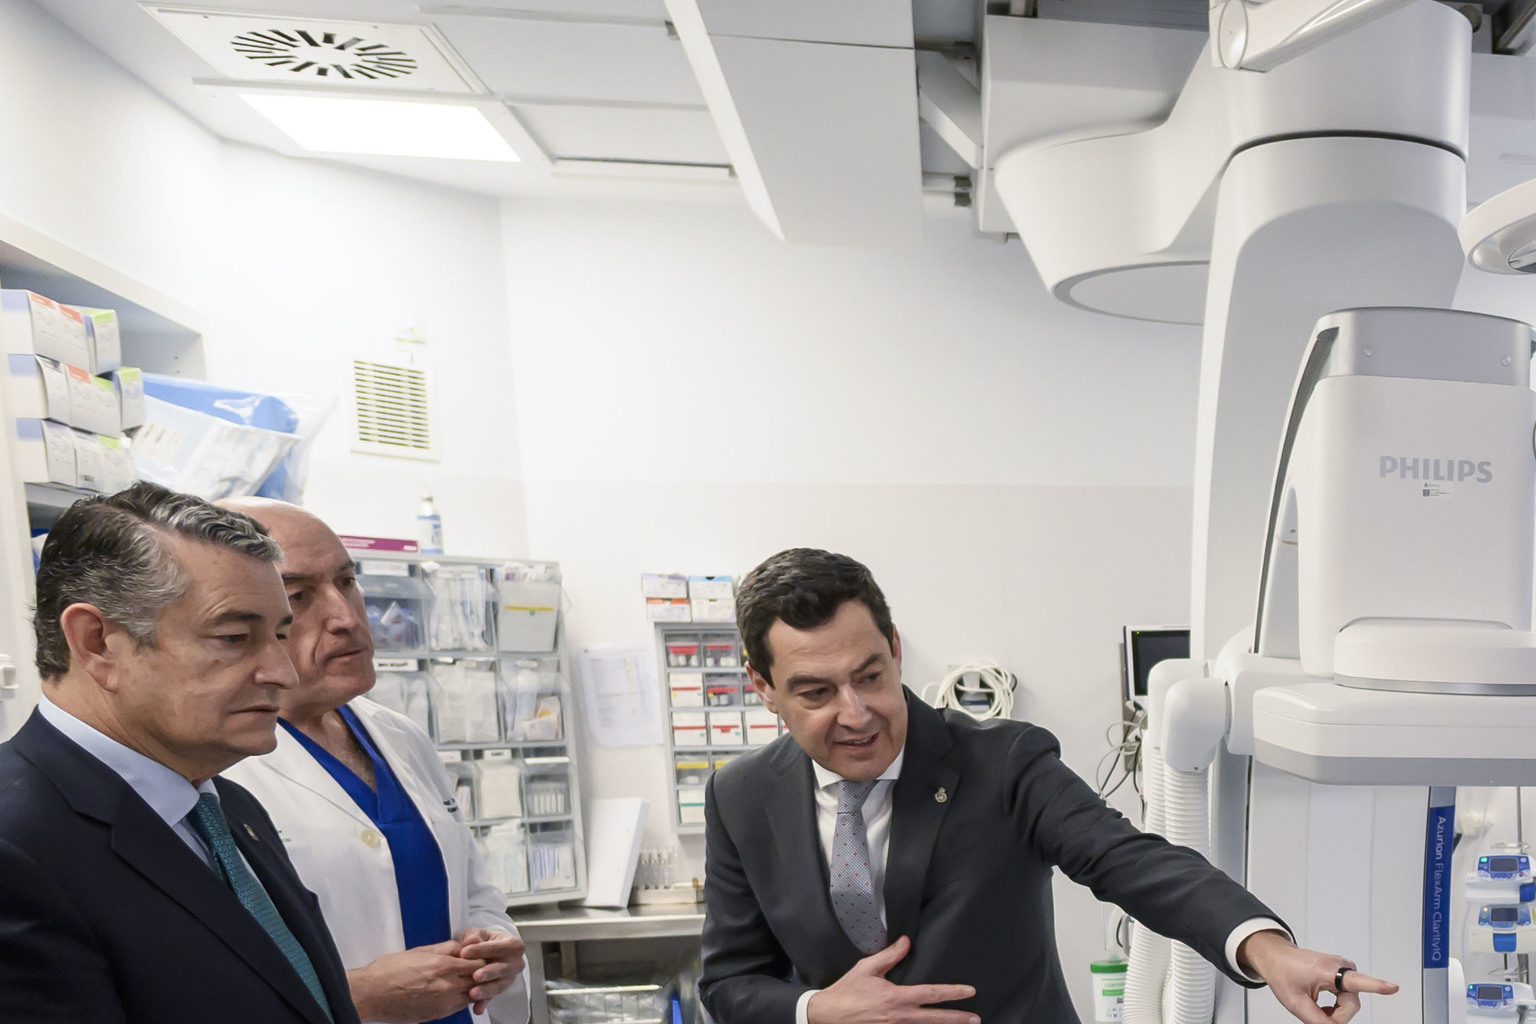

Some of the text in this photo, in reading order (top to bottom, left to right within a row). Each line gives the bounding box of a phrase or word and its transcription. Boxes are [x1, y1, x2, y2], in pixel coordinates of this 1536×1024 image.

[1379, 455, 1493, 484] PHILIPS
[1431, 816, 1447, 961] Azurion FlexArm ClarityIQ
